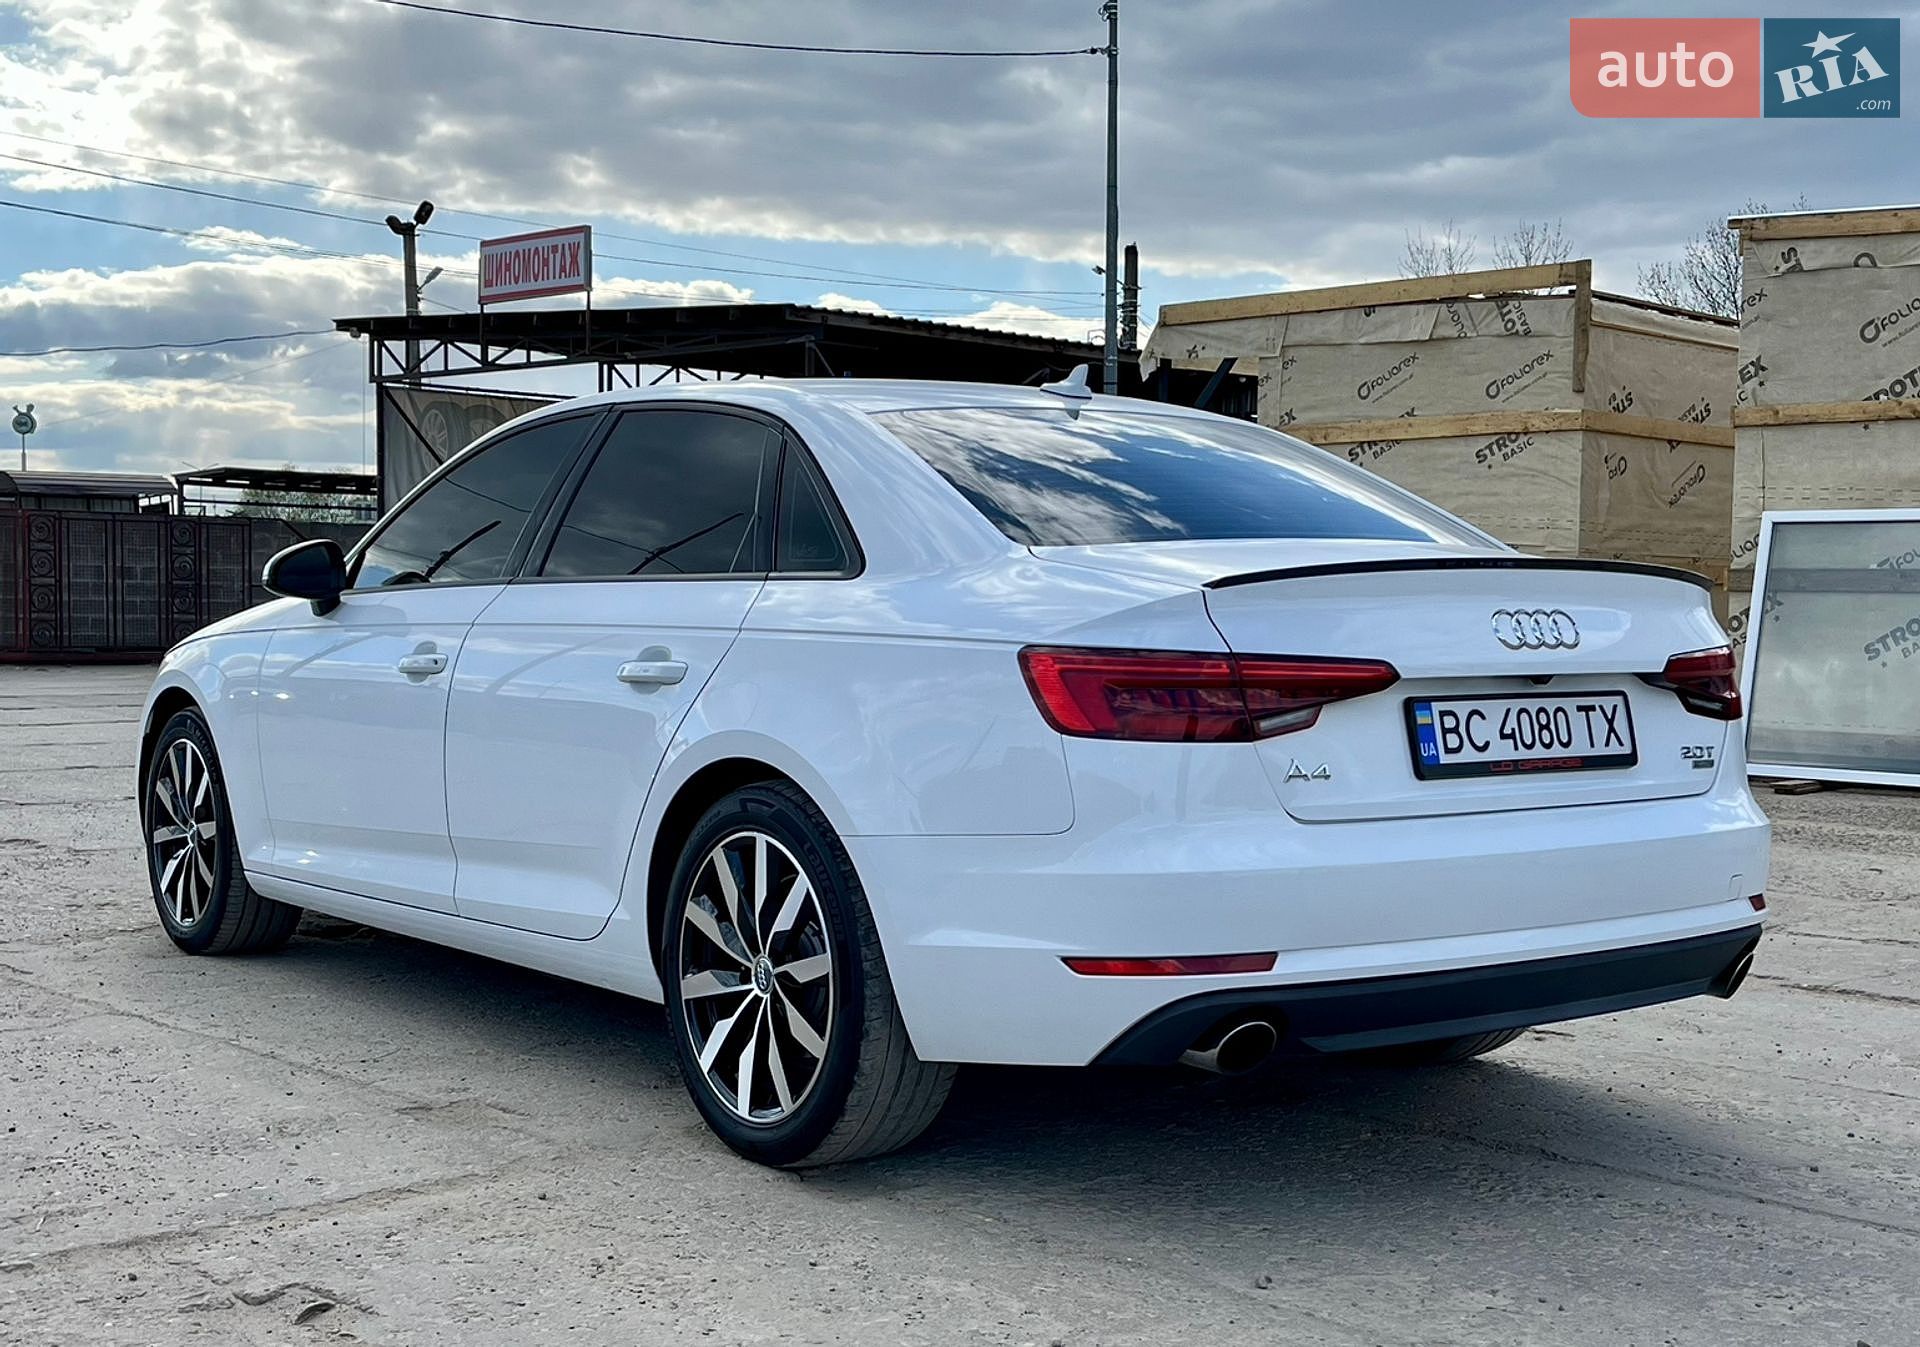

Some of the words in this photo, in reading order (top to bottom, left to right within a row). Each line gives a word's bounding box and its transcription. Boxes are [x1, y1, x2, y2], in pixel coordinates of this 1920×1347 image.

[484, 241, 581, 289] ШИНОМОНТАЖ
[1502, 436, 1535, 462] BASIC
[1438, 708, 1491, 755] BC
[1498, 705, 1572, 751] 4080
[1576, 703, 1625, 748] TX
[1420, 742, 1438, 757] UA
[1283, 758, 1332, 784] A4
